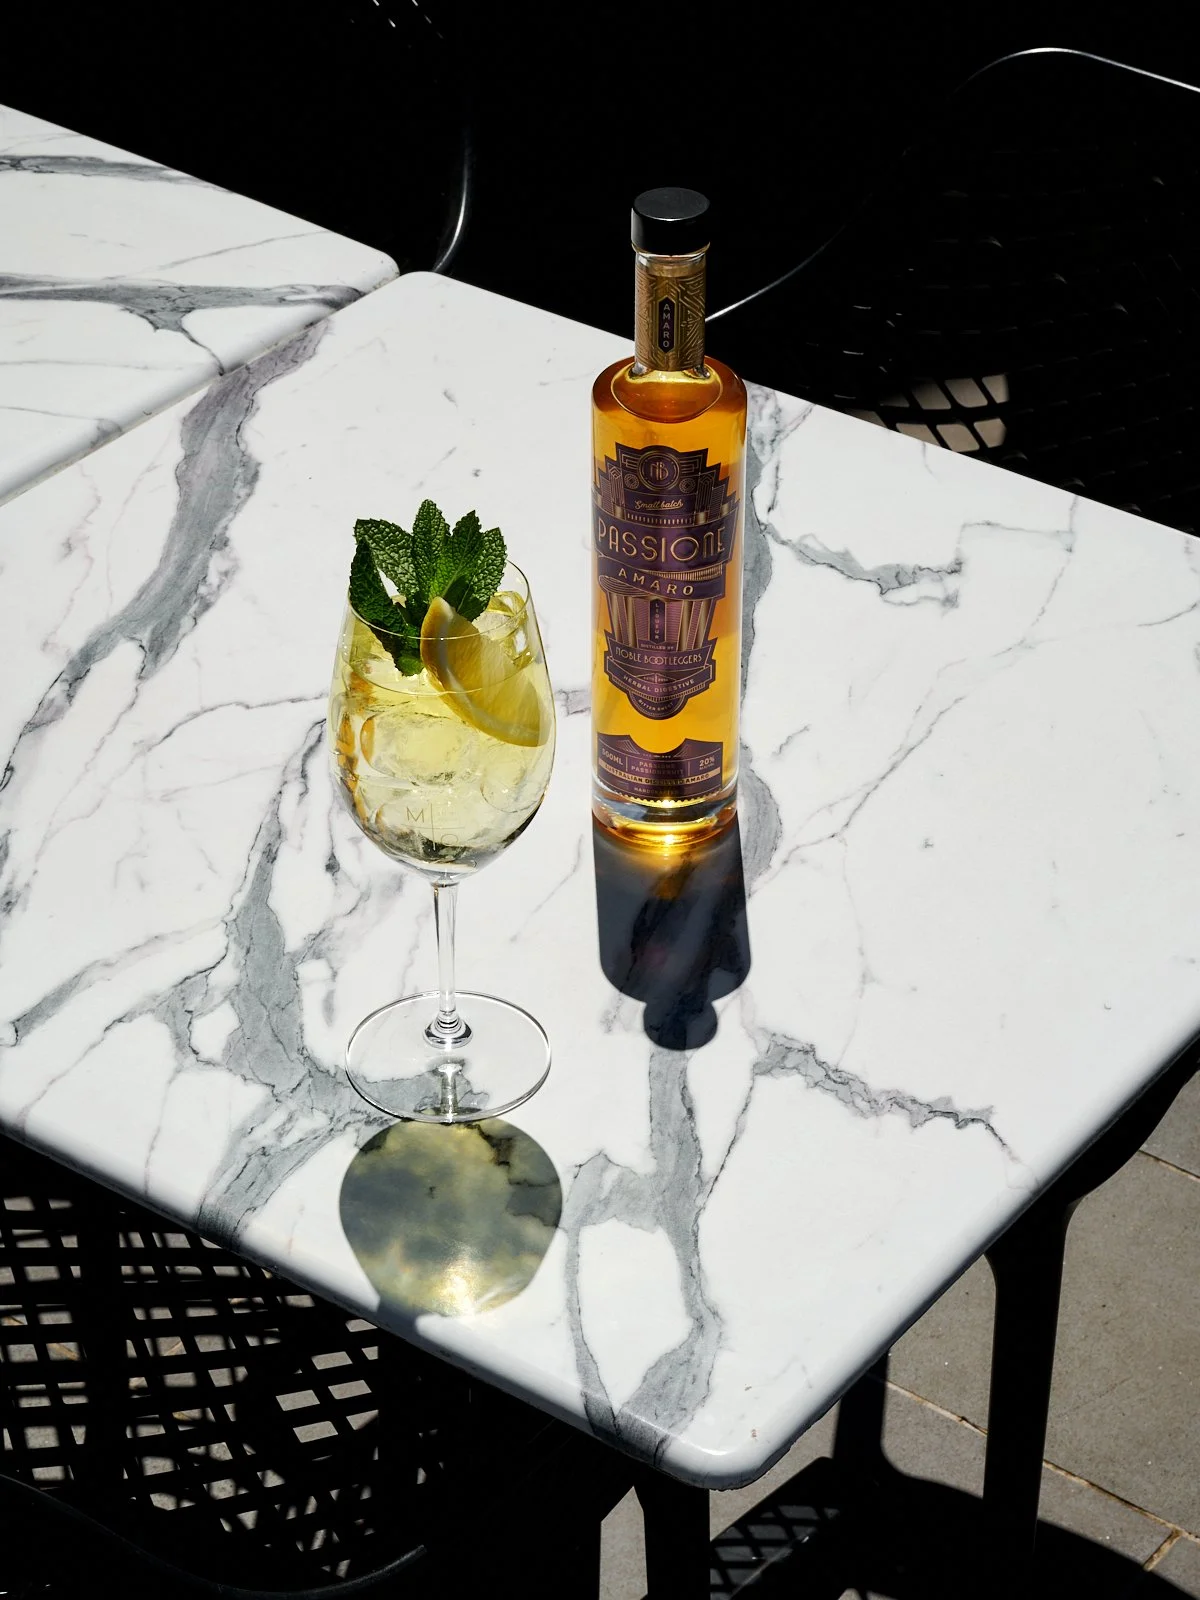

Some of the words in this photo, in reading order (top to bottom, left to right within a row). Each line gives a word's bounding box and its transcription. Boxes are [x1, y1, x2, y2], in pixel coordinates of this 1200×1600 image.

[662, 303, 670, 348] AMARO
[635, 500, 660, 510] Small
[660, 499, 684, 510] batch
[598, 517, 725, 563] PASSIONE
[618, 568, 694, 596] AMARO
[615, 646, 642, 663] NOBLE
[644, 654, 702, 666] BOOTLEGGERS
[623, 675, 651, 692] HERBAL
[654, 678, 695, 693] DIGESTIVE
[685, 773, 710, 784] AMARO
